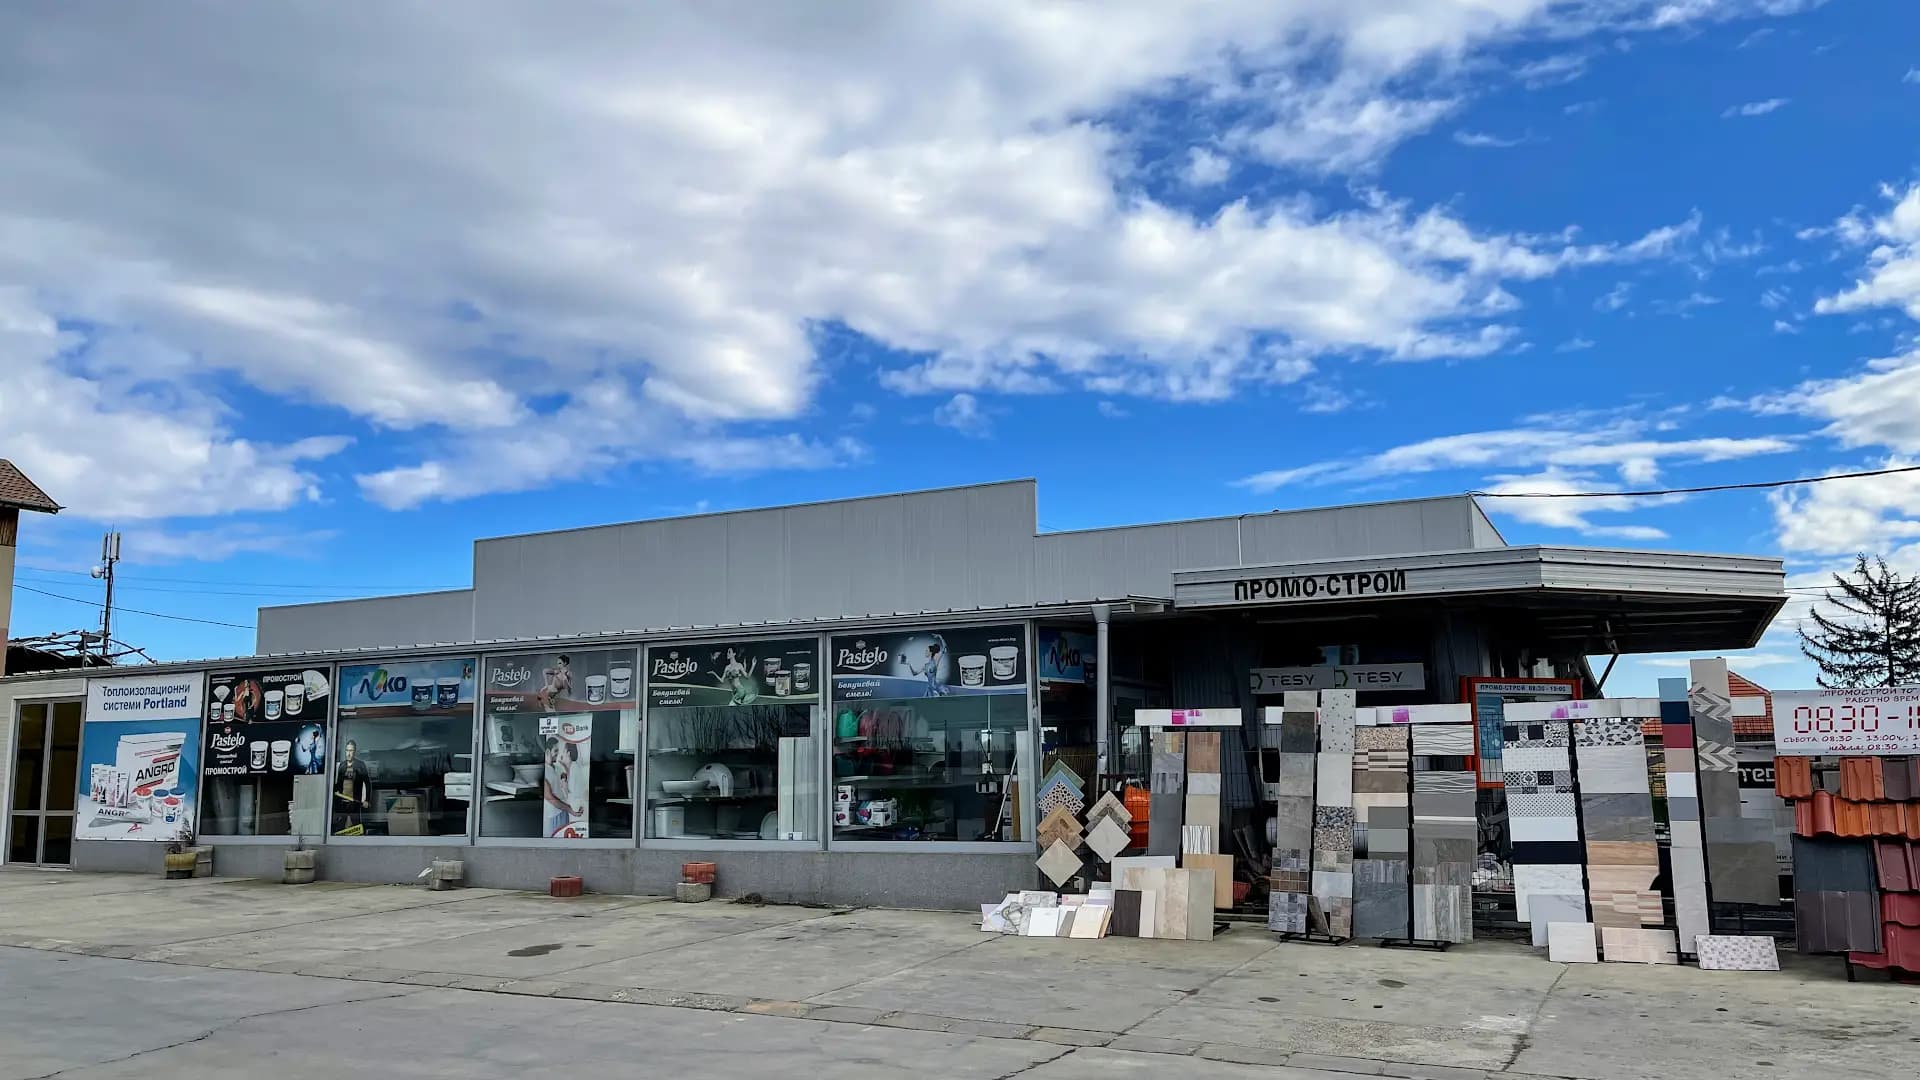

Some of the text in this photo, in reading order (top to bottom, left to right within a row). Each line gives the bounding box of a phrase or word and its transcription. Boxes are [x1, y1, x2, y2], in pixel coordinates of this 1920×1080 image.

[1234, 569, 1406, 601] ПРОМО-СТРОЙ
[837, 647, 888, 669] Pastelo
[491, 667, 531, 686] Pastelo
[652, 658, 698, 678] Pastelo
[1352, 671, 1403, 683] TESY
[262, 674, 302, 683] ПРОМОСТРОЙ
[1267, 674, 1315, 686] TESY
[102, 684, 190, 697] Топлоизолационни
[103, 696, 187, 711] системи Portland
[1794, 705, 1879, 734] 08.30
[210, 732, 245, 751] Pastelo
[136, 762, 175, 781] ANGRO
[205, 766, 247, 776] ПРОМОСТРОЙ
